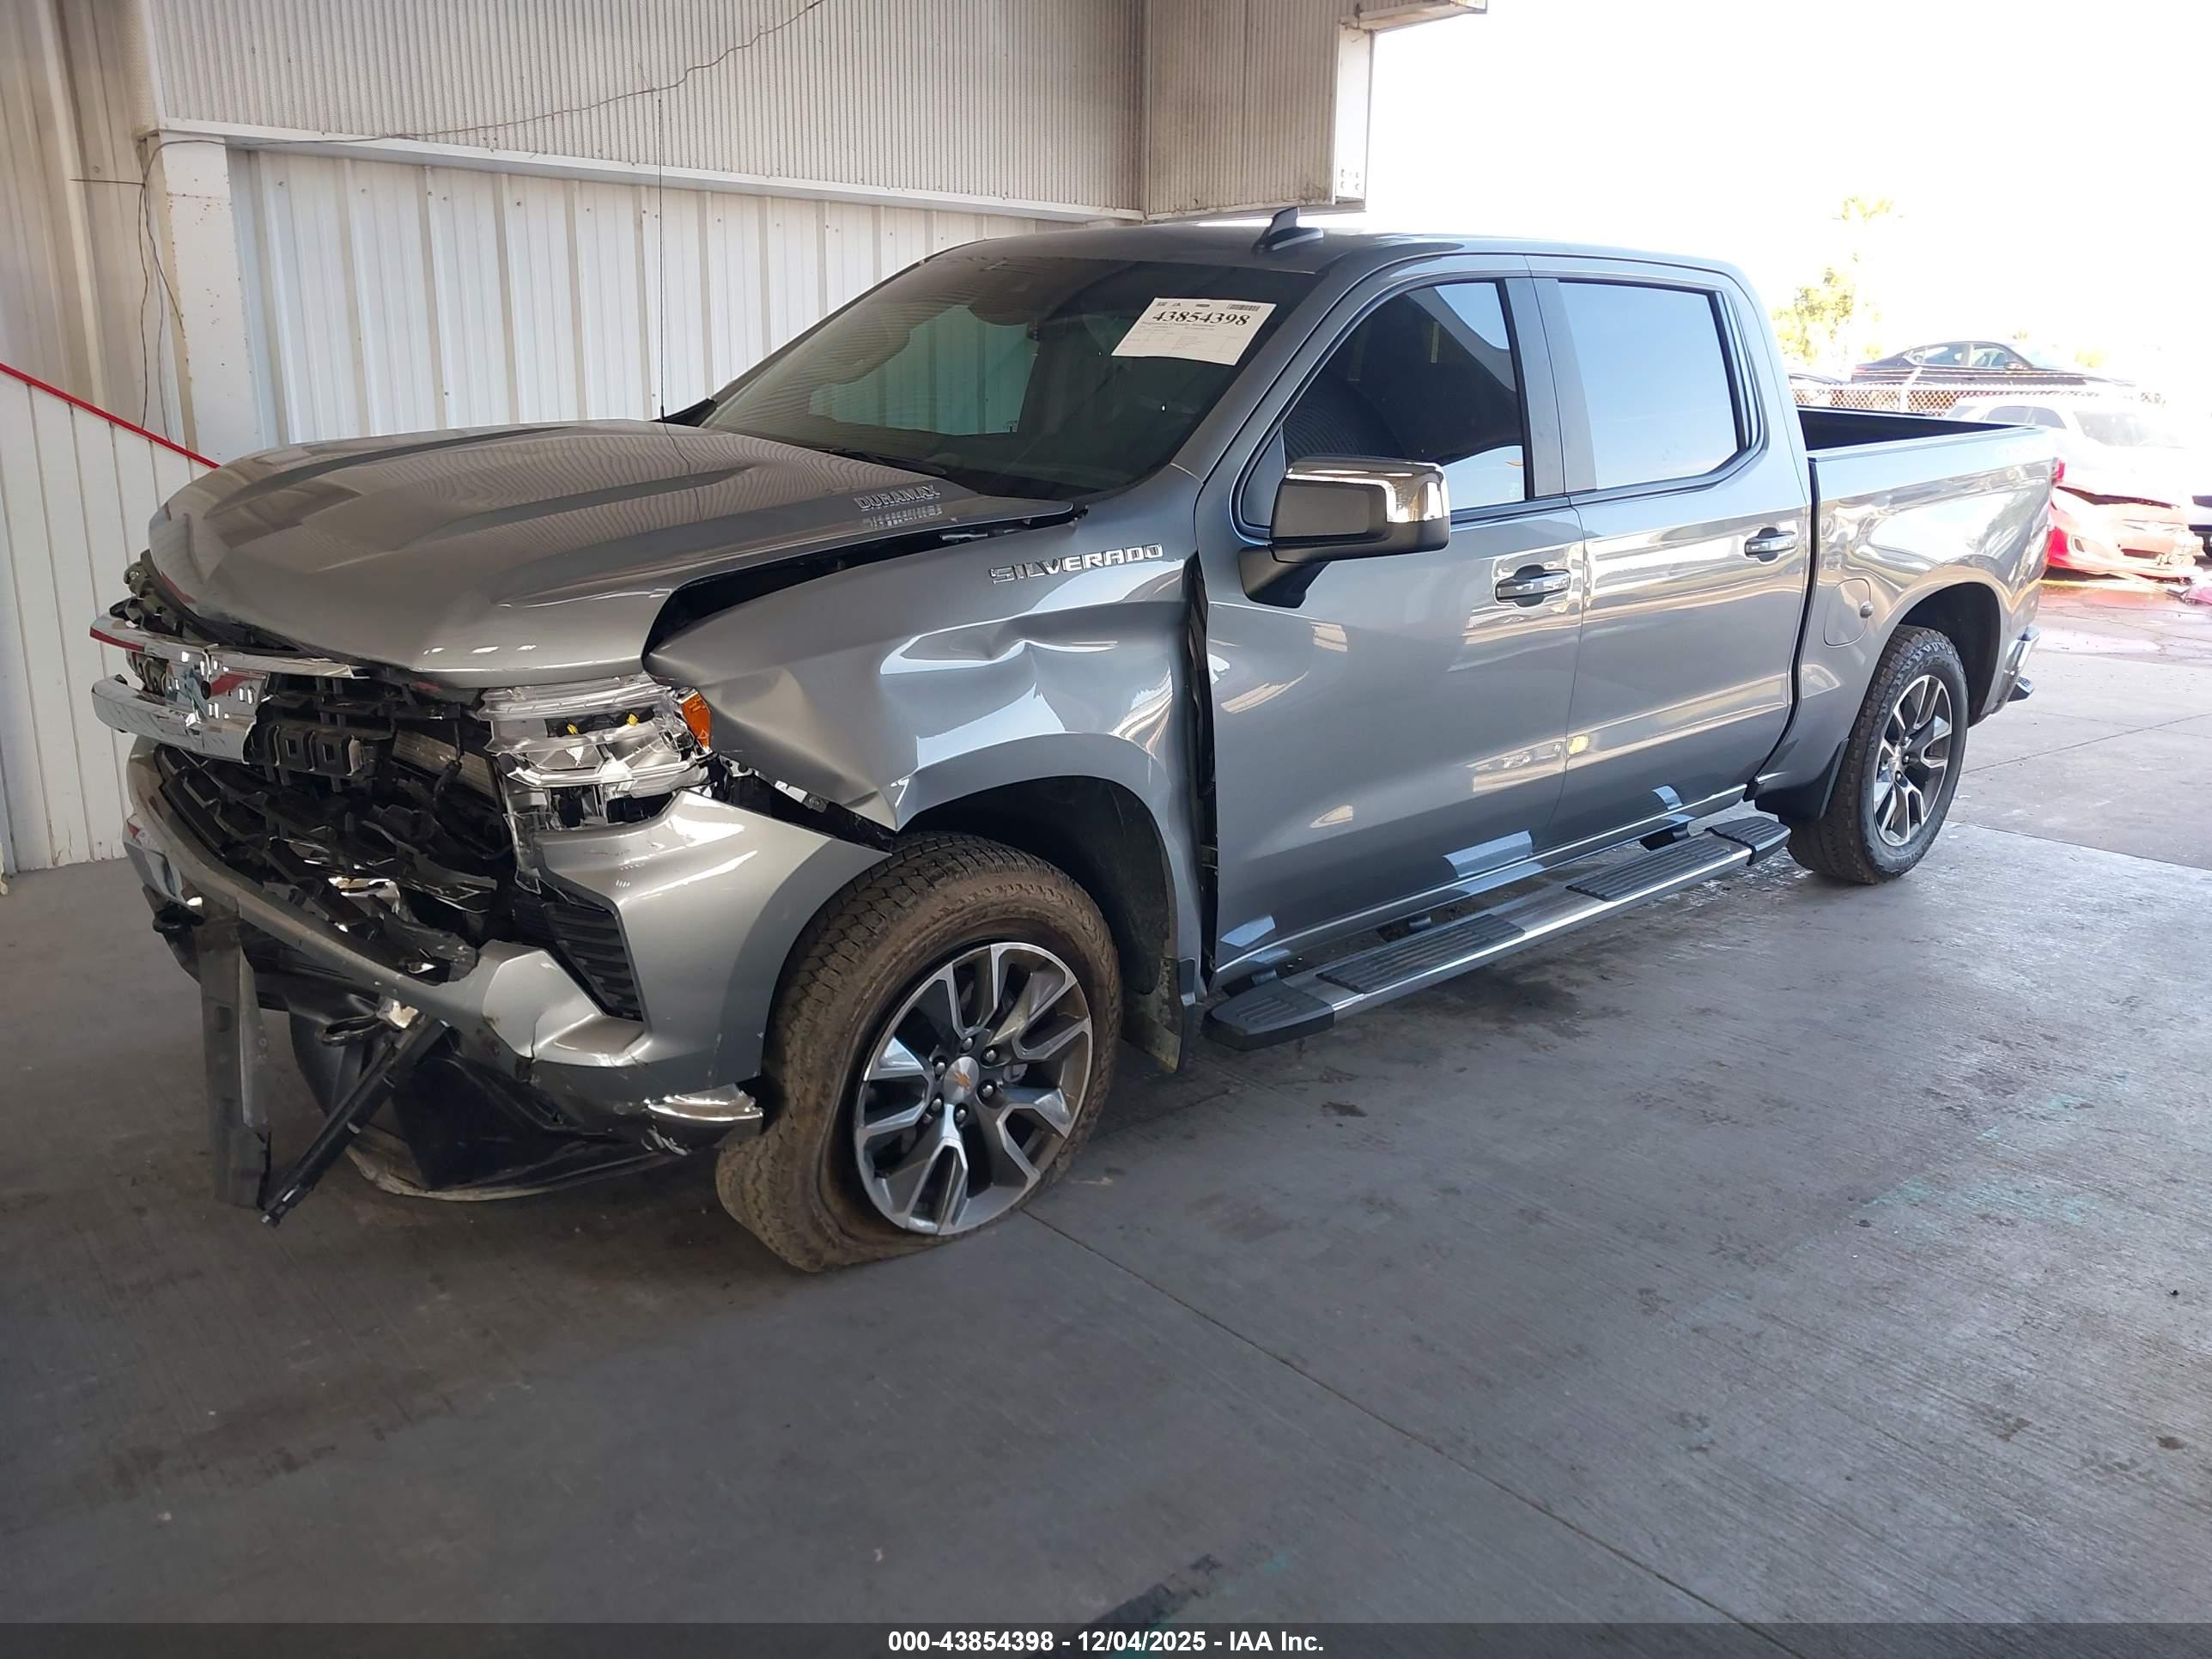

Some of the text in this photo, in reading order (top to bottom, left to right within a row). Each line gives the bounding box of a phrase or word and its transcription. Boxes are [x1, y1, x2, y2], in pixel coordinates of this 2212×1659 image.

[1152, 311, 1251, 325] 43854398
[854, 485, 941, 511] DURAMAX
[989, 544, 1164, 584] SILVERADO
